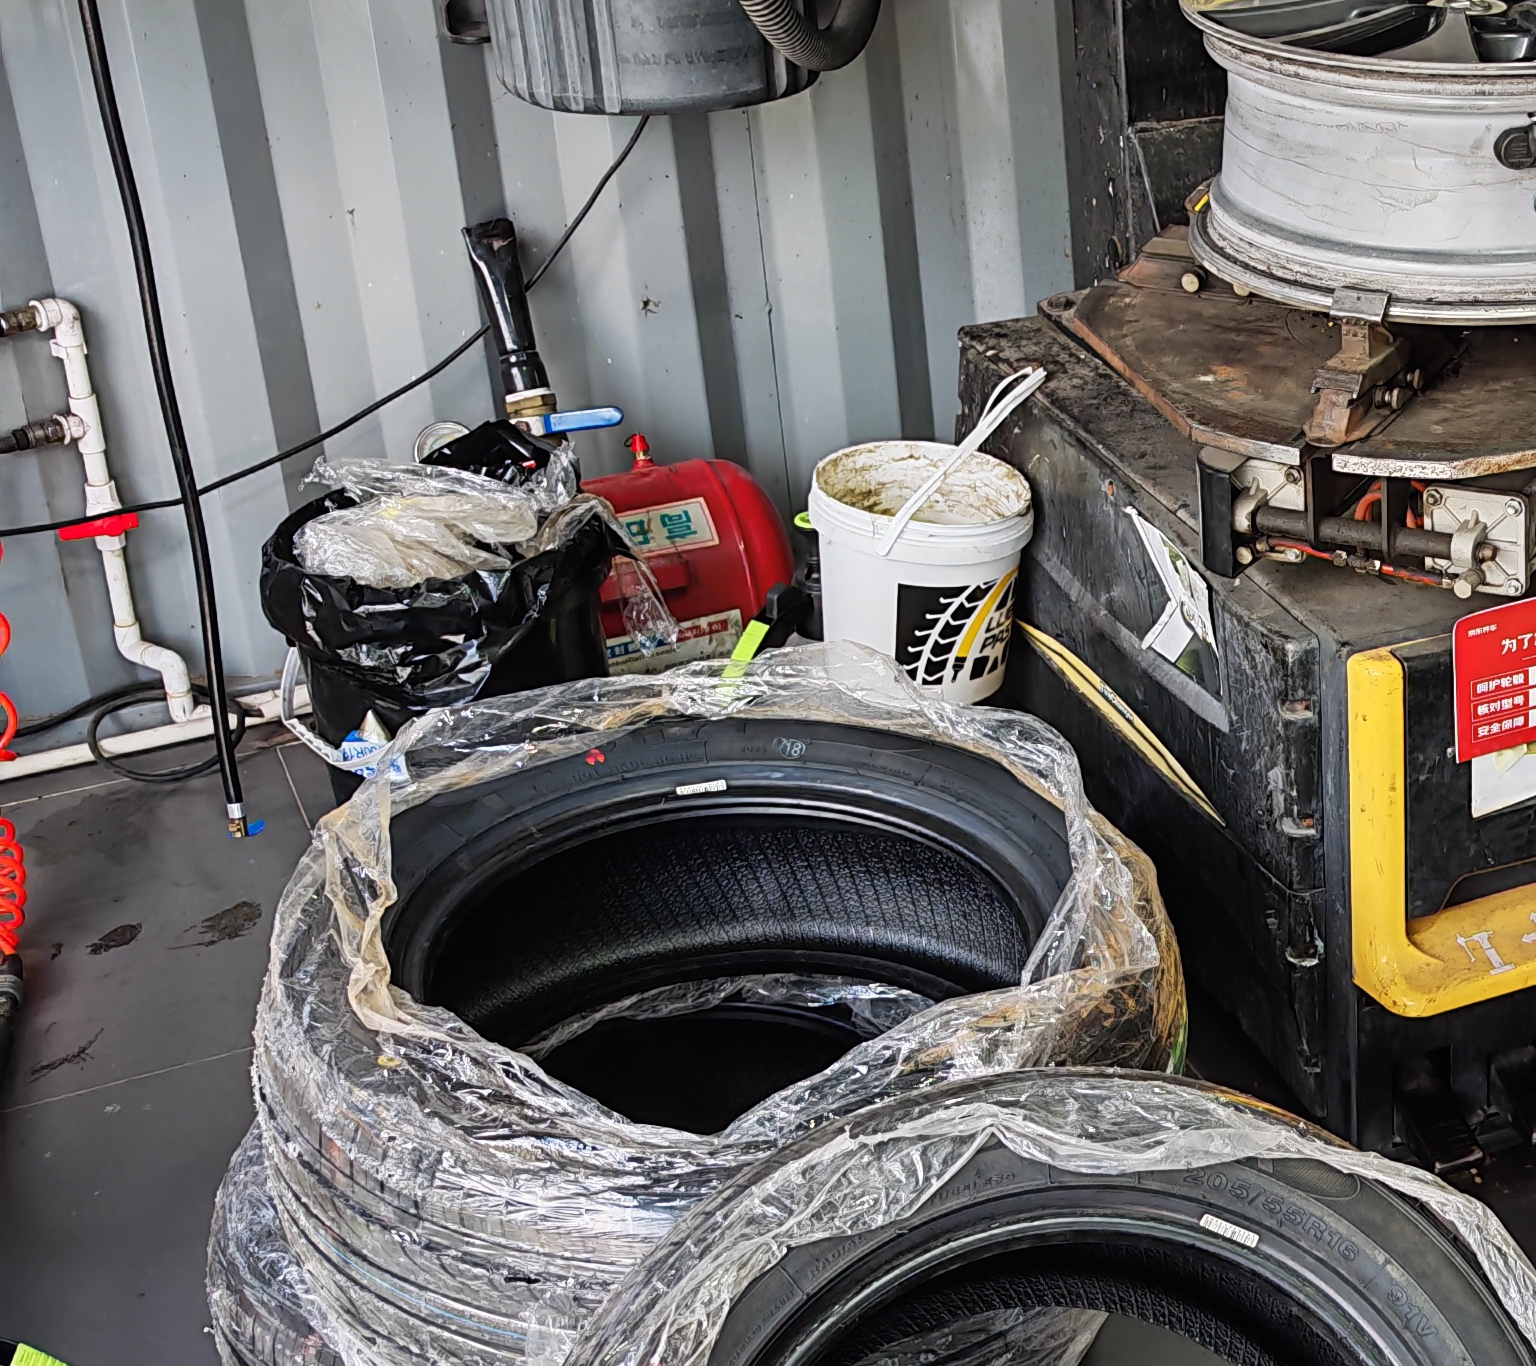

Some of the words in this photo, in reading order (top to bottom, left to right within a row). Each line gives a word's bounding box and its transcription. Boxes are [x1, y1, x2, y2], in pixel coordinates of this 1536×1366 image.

[1477, 695, 1525, 717] 核对型号
[1477, 715, 1525, 738] 安全保障
[1182, 1167, 1360, 1263] 205/55R16
[1386, 1285, 1439, 1339] 91V
